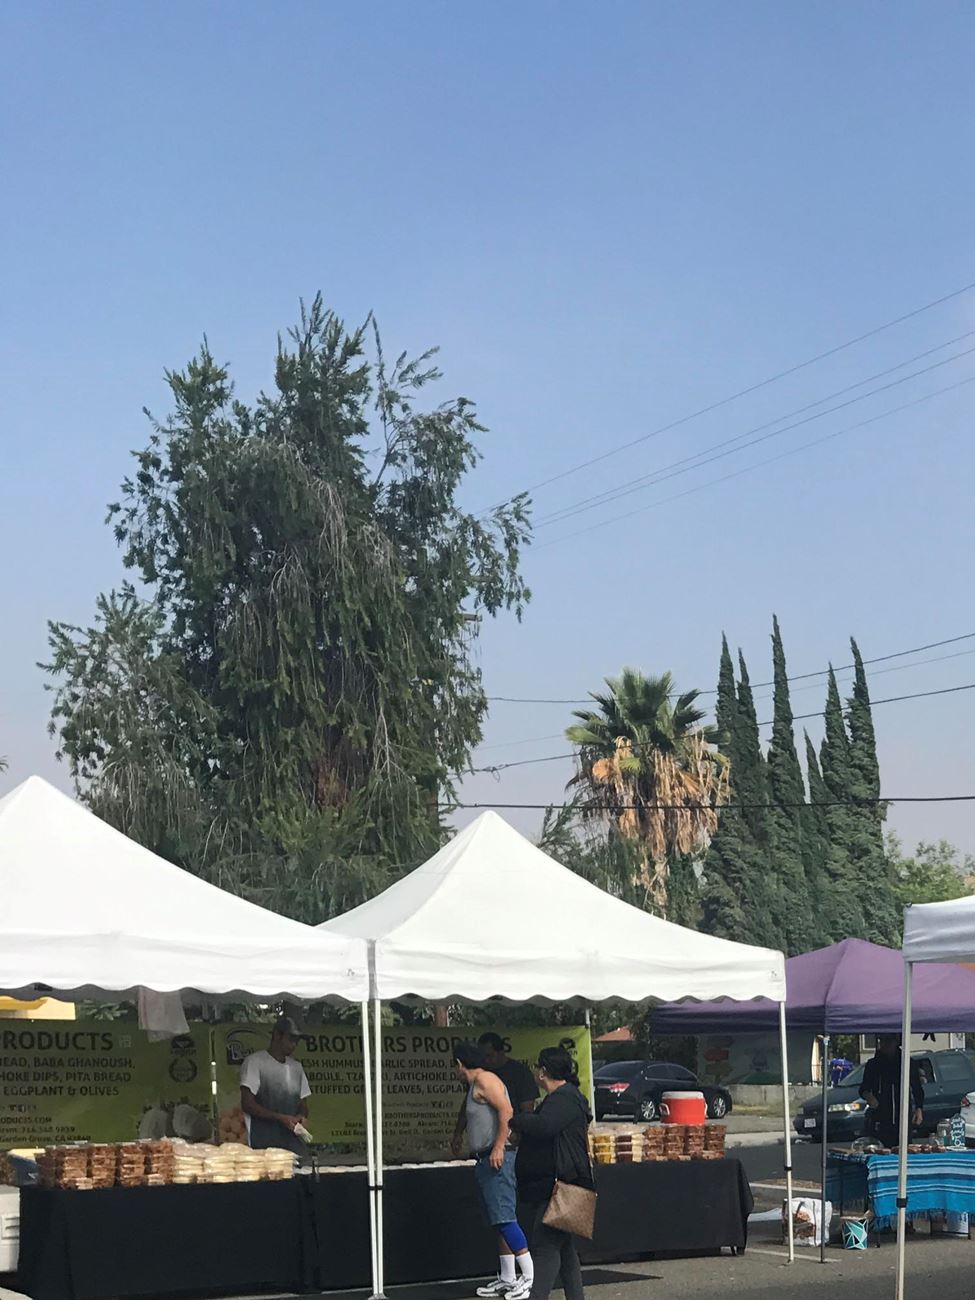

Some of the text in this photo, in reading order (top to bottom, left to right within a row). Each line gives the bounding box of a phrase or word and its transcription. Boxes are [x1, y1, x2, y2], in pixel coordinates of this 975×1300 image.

[0, 1031, 113, 1051] RODUCTS
[306, 1035, 512, 1052] BROTRS PRODS
[0, 1057, 136, 1070] EAD, BABA GHANOUSH,
[409, 1059, 448, 1070] SPREAD,
[33, 1071, 63, 1083] DIPS,
[66, 1071, 90, 1082] PITA
[94, 1072, 132, 1082] BREAD
[394, 1072, 447, 1081] ARTICHOKE
[3, 1086, 120, 1097] EGGPLANT & OLIVES
[387, 1085, 425, 1096] LEAVES,
